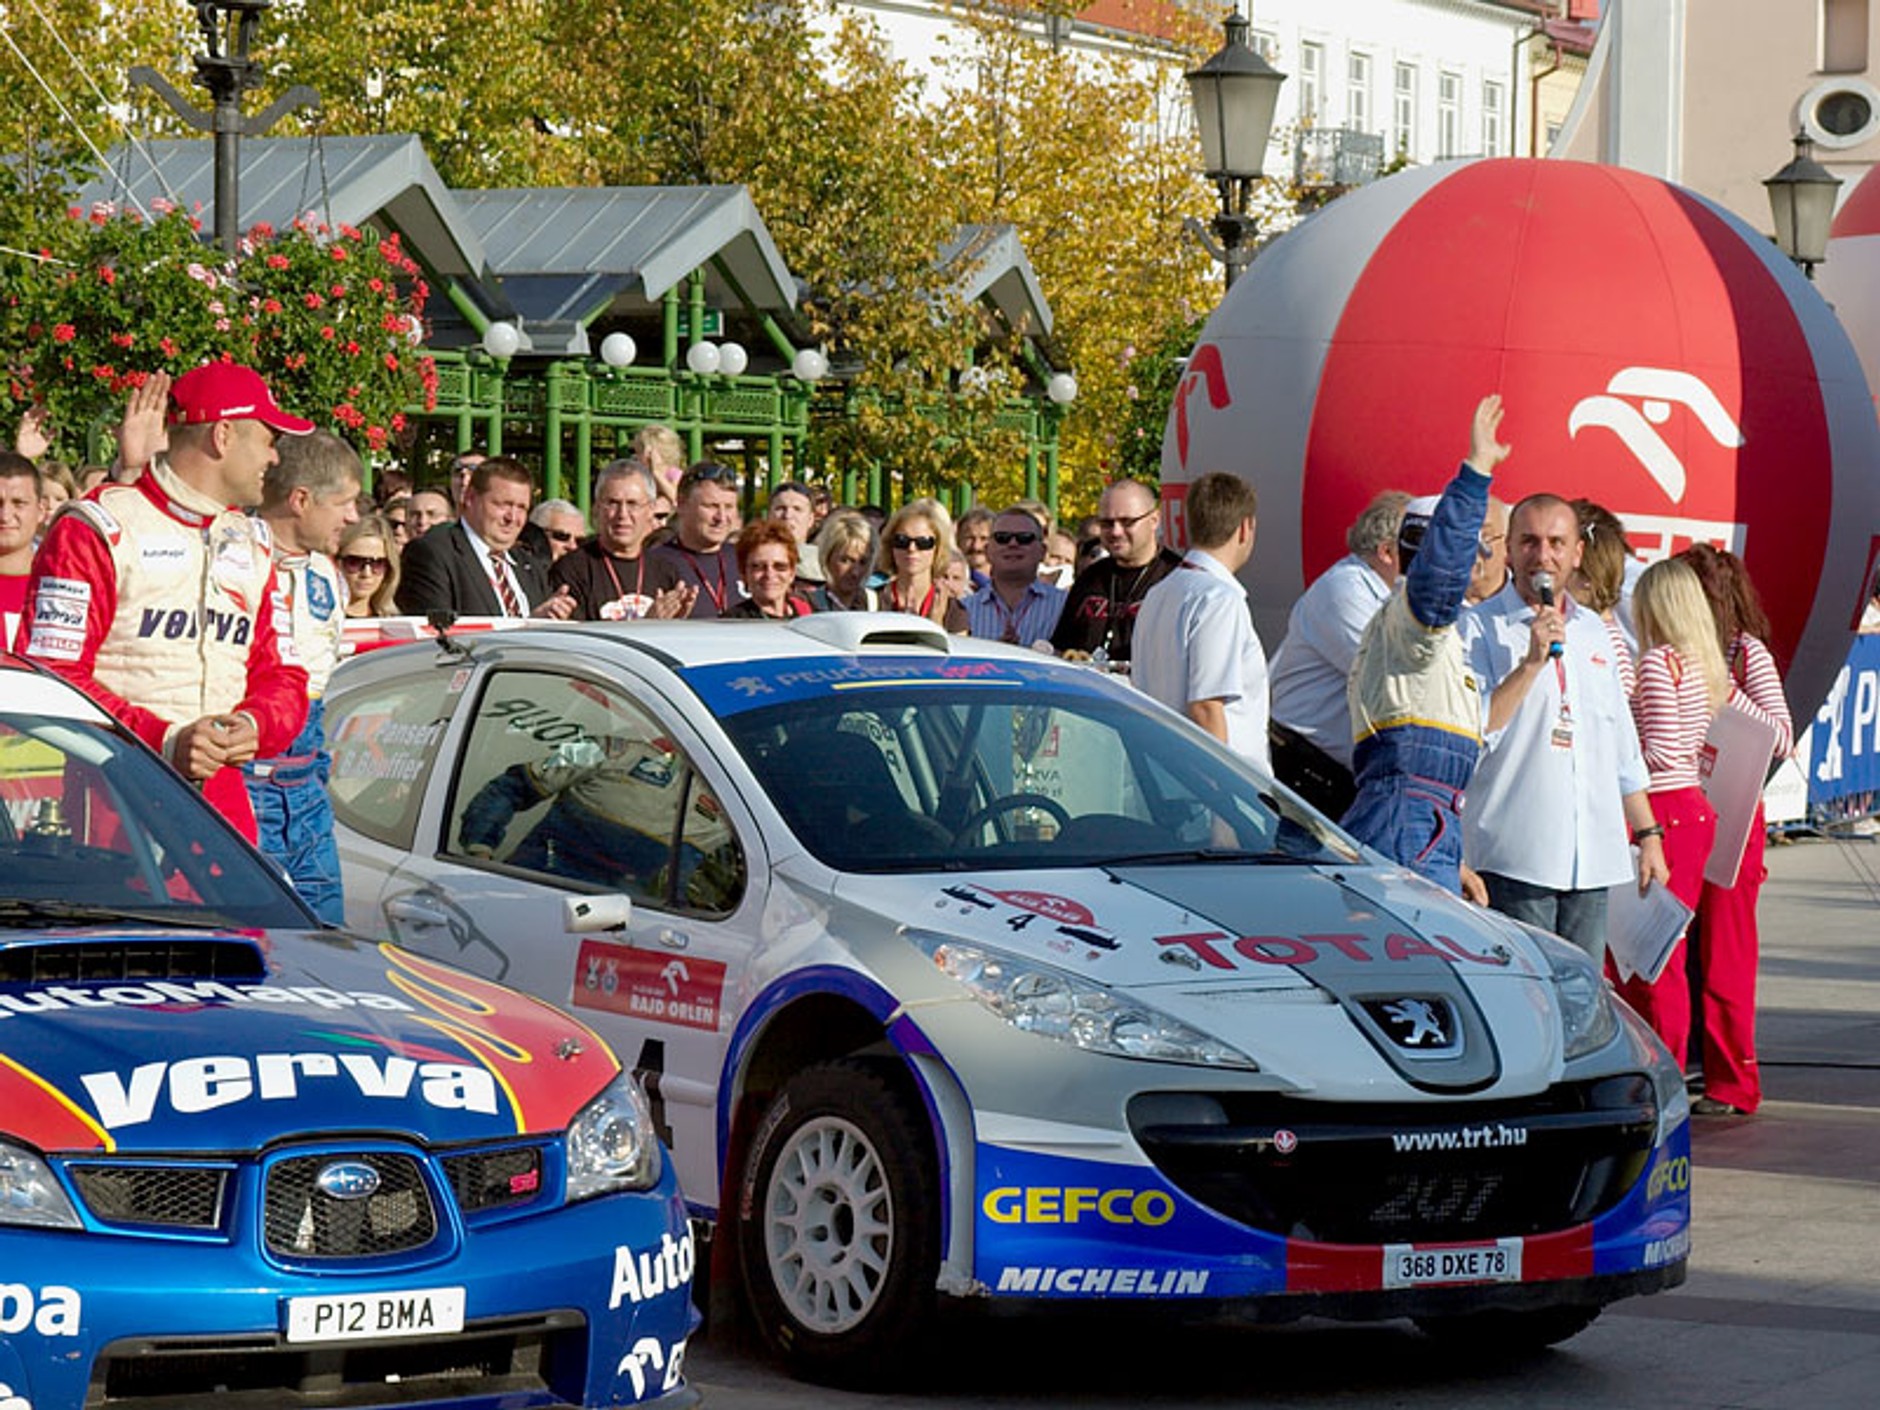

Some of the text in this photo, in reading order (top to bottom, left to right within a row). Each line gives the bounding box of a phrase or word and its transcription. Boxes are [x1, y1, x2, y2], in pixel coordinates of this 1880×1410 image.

[137, 606, 251, 646] verva
[1007, 914, 1037, 932] 4
[1154, 931, 1512, 970] TOTAL
[630, 993, 665, 1015] RAJD
[668, 1000, 714, 1025] ORLEN
[80, 1052, 499, 1130] verva
[1392, 1124, 1528, 1152] www.trt.hu
[982, 1187, 1175, 1226] GEFCO
[608, 1218, 695, 1310] Auto
[996, 1266, 1210, 1295] MICHELIN
[1402, 1251, 1506, 1278] 368 DXE 78
[314, 1298, 435, 1334] P12 BMA
